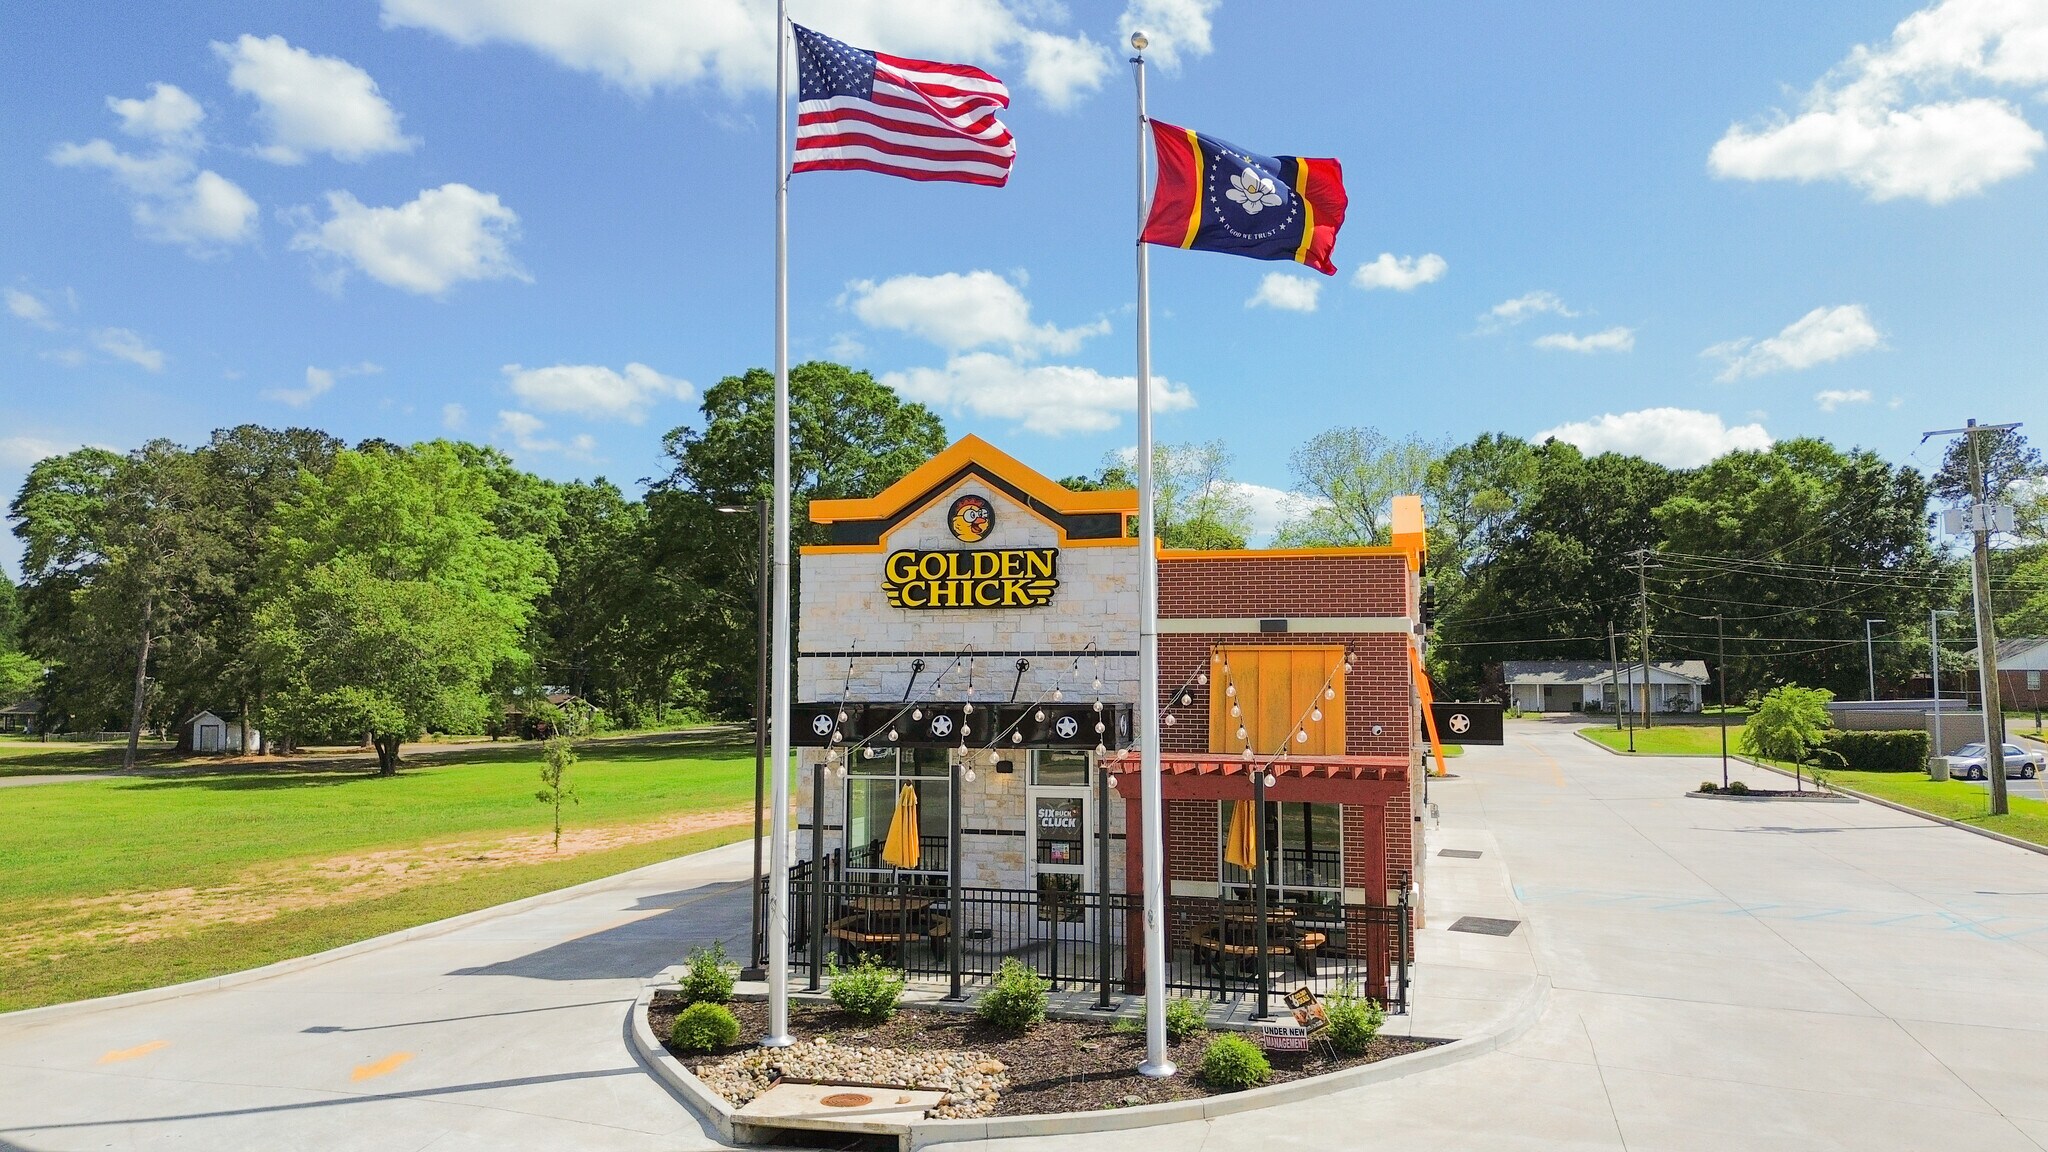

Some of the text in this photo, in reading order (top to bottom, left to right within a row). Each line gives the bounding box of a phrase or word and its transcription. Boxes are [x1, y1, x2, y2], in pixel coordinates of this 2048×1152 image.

[1254, 228, 1276, 240] TRUST
[886, 550, 1055, 584] GOLDEN
[901, 579, 1035, 606] CHICK
[1041, 817, 1076, 828] CLUCK
[1264, 1026, 1305, 1037] UNDER NEW
[1265, 1035, 1307, 1049] MANAGEMENT
